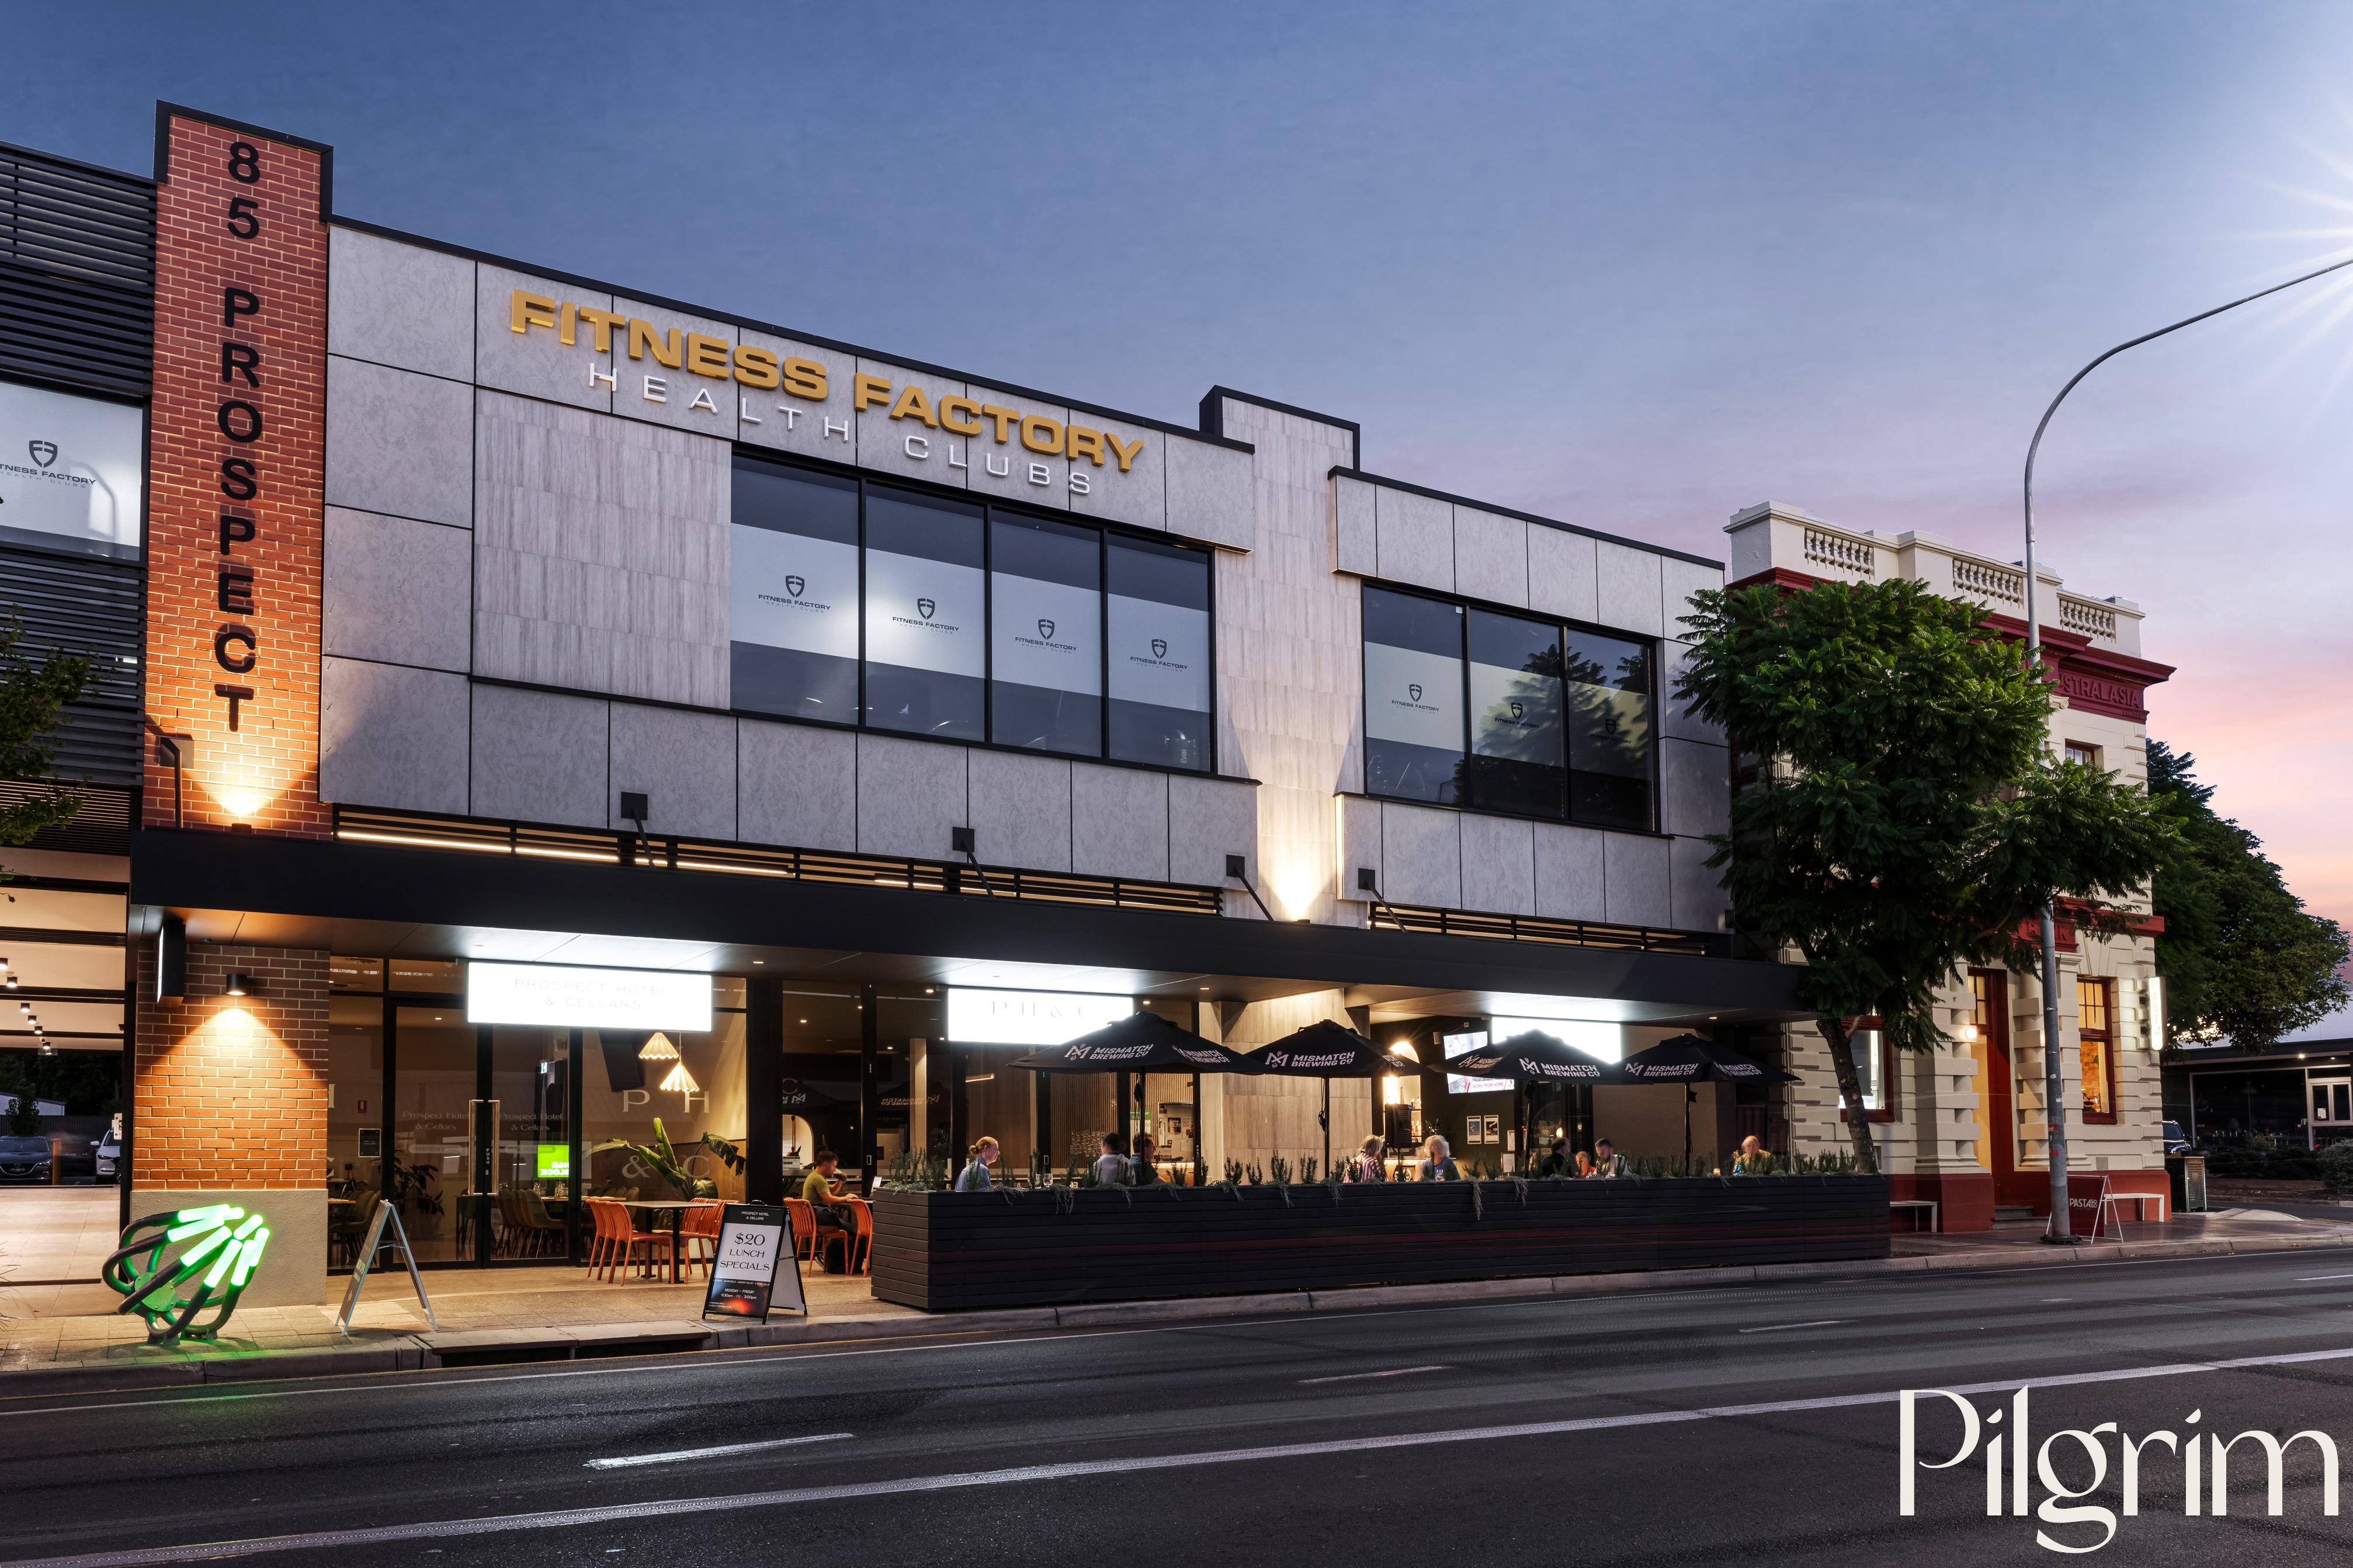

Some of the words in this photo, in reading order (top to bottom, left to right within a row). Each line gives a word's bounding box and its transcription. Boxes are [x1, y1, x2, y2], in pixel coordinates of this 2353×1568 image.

[511, 289, 828, 401] FITNESS
[855, 373, 1144, 472] FACTORY
[589, 363, 849, 443] HEALTH
[904, 435, 1091, 496] CLUBS
[41, 471, 96, 485] FACTORY
[50, 479, 86, 488] CLUBS
[214, 287, 262, 732] PROSPECT
[758, 594, 792, 604] FITNESS
[794, 600, 831, 610] FACTORY
[892, 616, 924, 625] FITNESS
[925, 622, 960, 631] FACTORY
[1015, 637, 1043, 645] FITNESS
[1046, 642, 1077, 651] FACTORY
[1130, 656, 1157, 665] FITNESS
[1158, 661, 1188, 669] FACTORY
[515, 978, 607, 993] PROSPECT
[616, 985, 669, 996] HOTEL
[565, 997, 641, 1010] CELLARS
[1093, 1044, 1154, 1054] MISMATCH
[1293, 1051, 1355, 1062] MISMATCH
[1540, 1063, 1598, 1072] MISMATCH
[1646, 1063, 1698, 1072] MISMATCH
[622, 1090, 650, 1112] P
[683, 1090, 710, 1113] H
[403, 1111, 443, 1119] Prospect
[2069, 1198, 2091, 1208] PASTA
[734, 1232, 765, 1246] $20
[729, 1249, 765, 1258] LUNCH
[719, 1260, 771, 1271] SPECIALS
